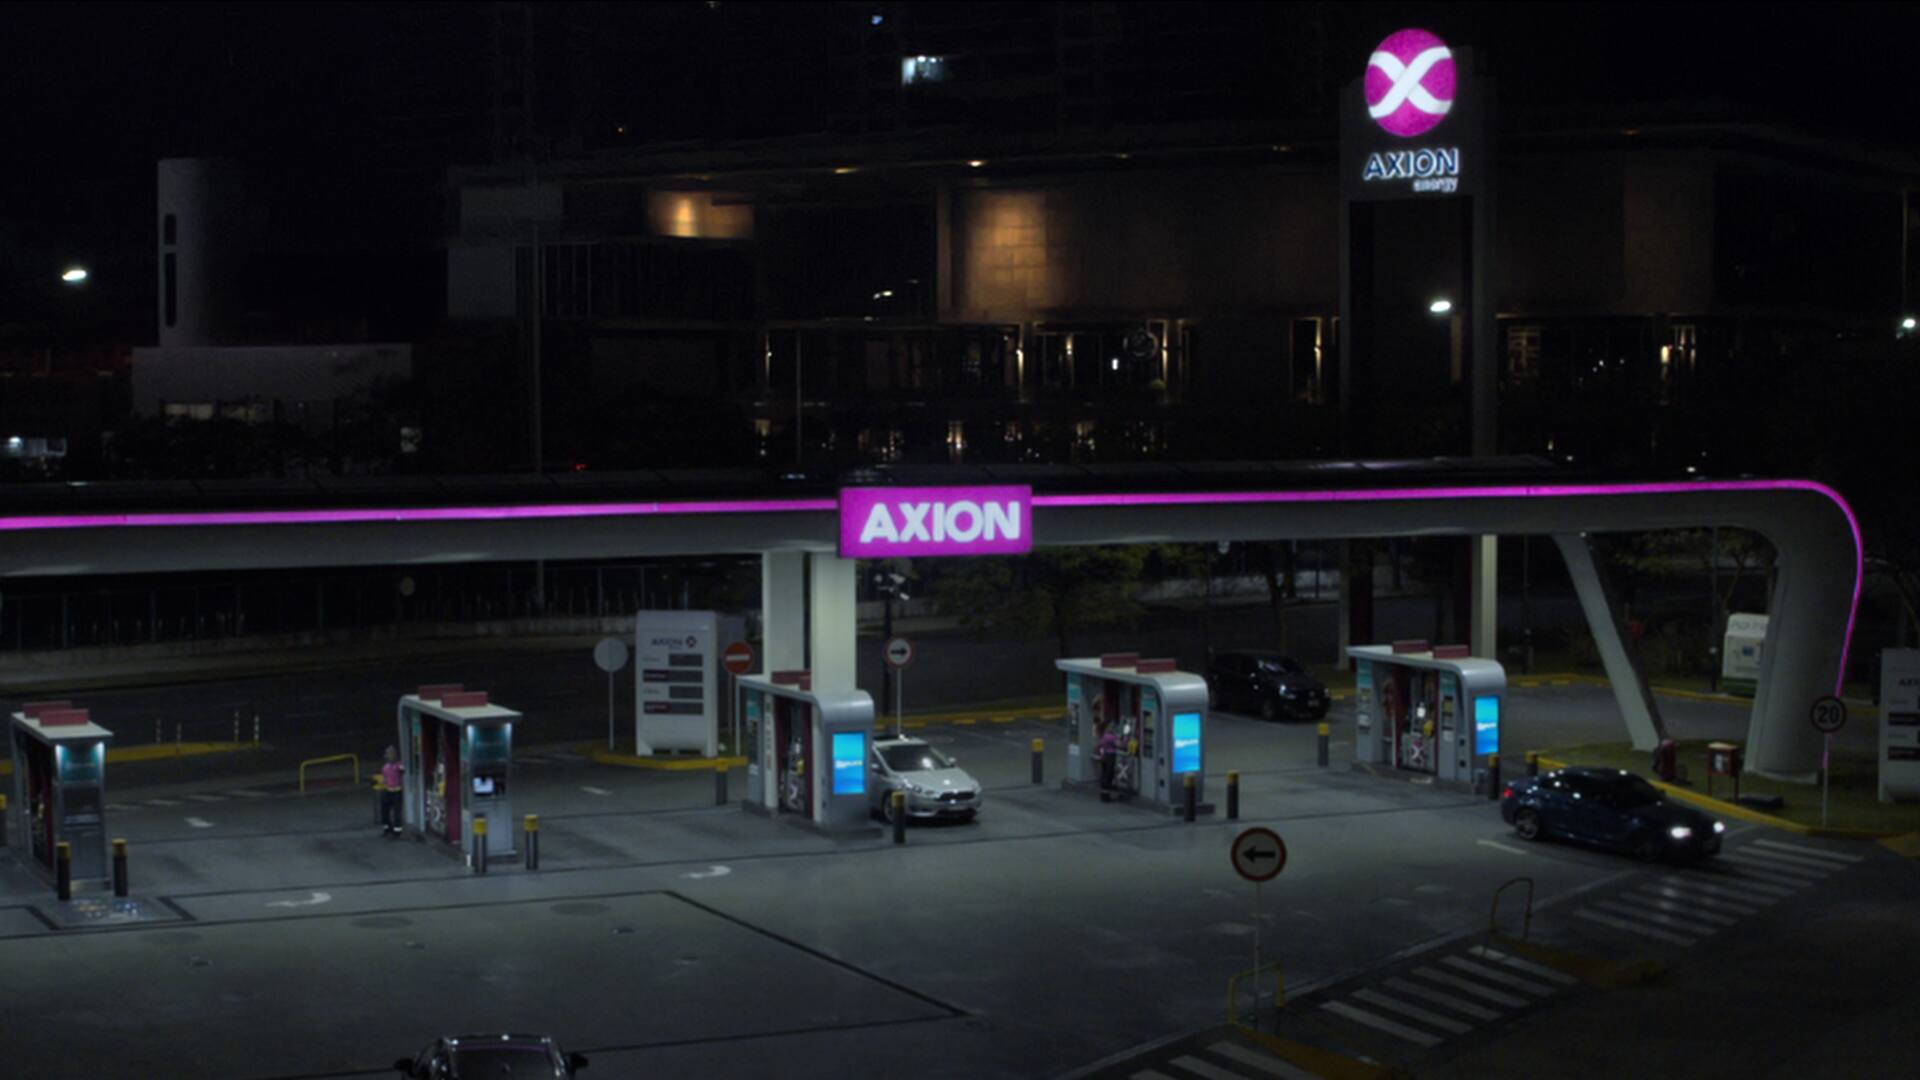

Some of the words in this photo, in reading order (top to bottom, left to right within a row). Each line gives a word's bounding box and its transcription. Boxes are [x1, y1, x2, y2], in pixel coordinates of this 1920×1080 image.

[1363, 149, 1459, 180] AXION
[859, 501, 1021, 543] AXION
[1817, 705, 1839, 724] 20
